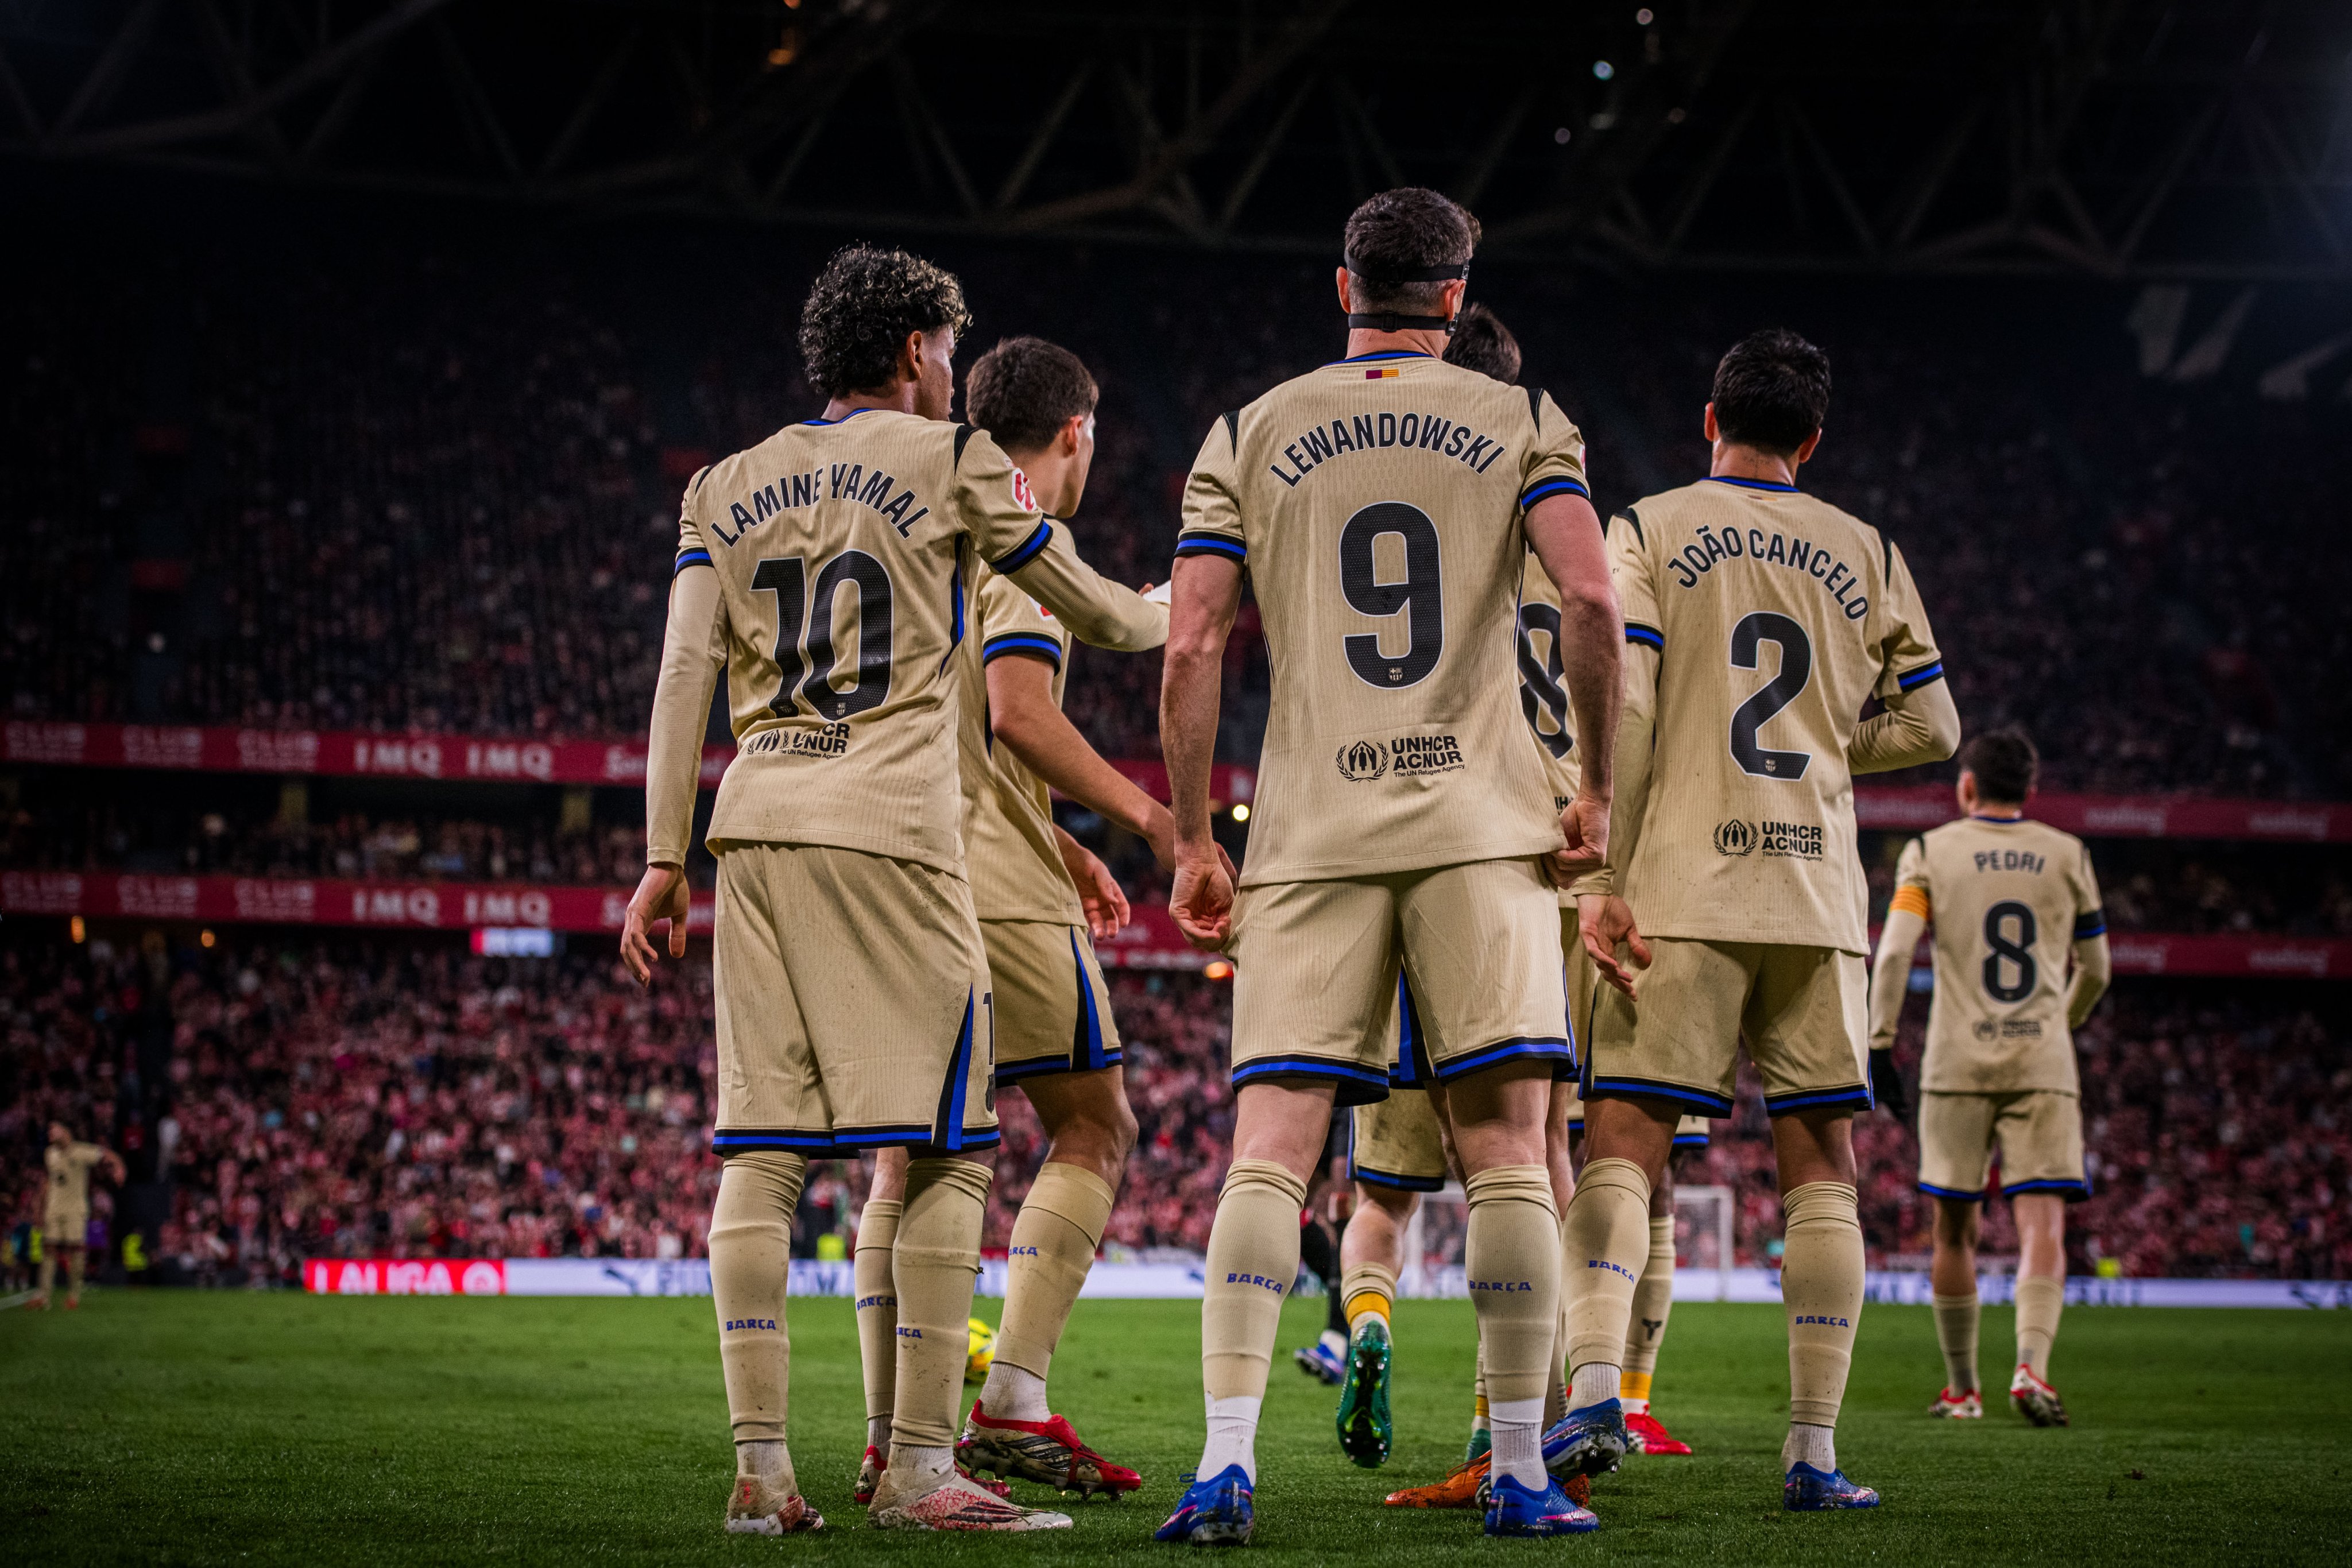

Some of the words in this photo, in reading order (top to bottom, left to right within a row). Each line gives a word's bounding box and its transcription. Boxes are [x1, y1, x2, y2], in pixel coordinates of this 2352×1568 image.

[1270, 412, 1505, 488] LEWANDOWSKI
[710, 467, 823, 549] LAMINE
[830, 462, 930, 540] YAMAL
[1667, 524, 1743, 590] JOÃO
[1748, 528, 1869, 622] CANCELO
[1338, 501, 1445, 690] 9
[748, 548, 894, 722] 10
[1730, 611, 1813, 782] 2
[798, 750, 822, 758] Refugee
[1391, 735, 1459, 754] UNHCR
[1393, 750, 1464, 771] ACNUR
[1442, 764, 1465, 772] Agency
[1762, 821, 1823, 841] UNHCR
[1761, 836, 1823, 855] ACNUR
[1974, 850, 2045, 874] PEDRI
[1982, 900, 2037, 1004] 8
[1589, 1260, 1634, 1284] BARÇA
[1227, 1273, 1283, 1294] BARÇA
[1469, 1280, 1532, 1292] BARÇA
[726, 1319, 776, 1331] BARÇA
[1796, 1315, 1848, 1327] BARÇA
